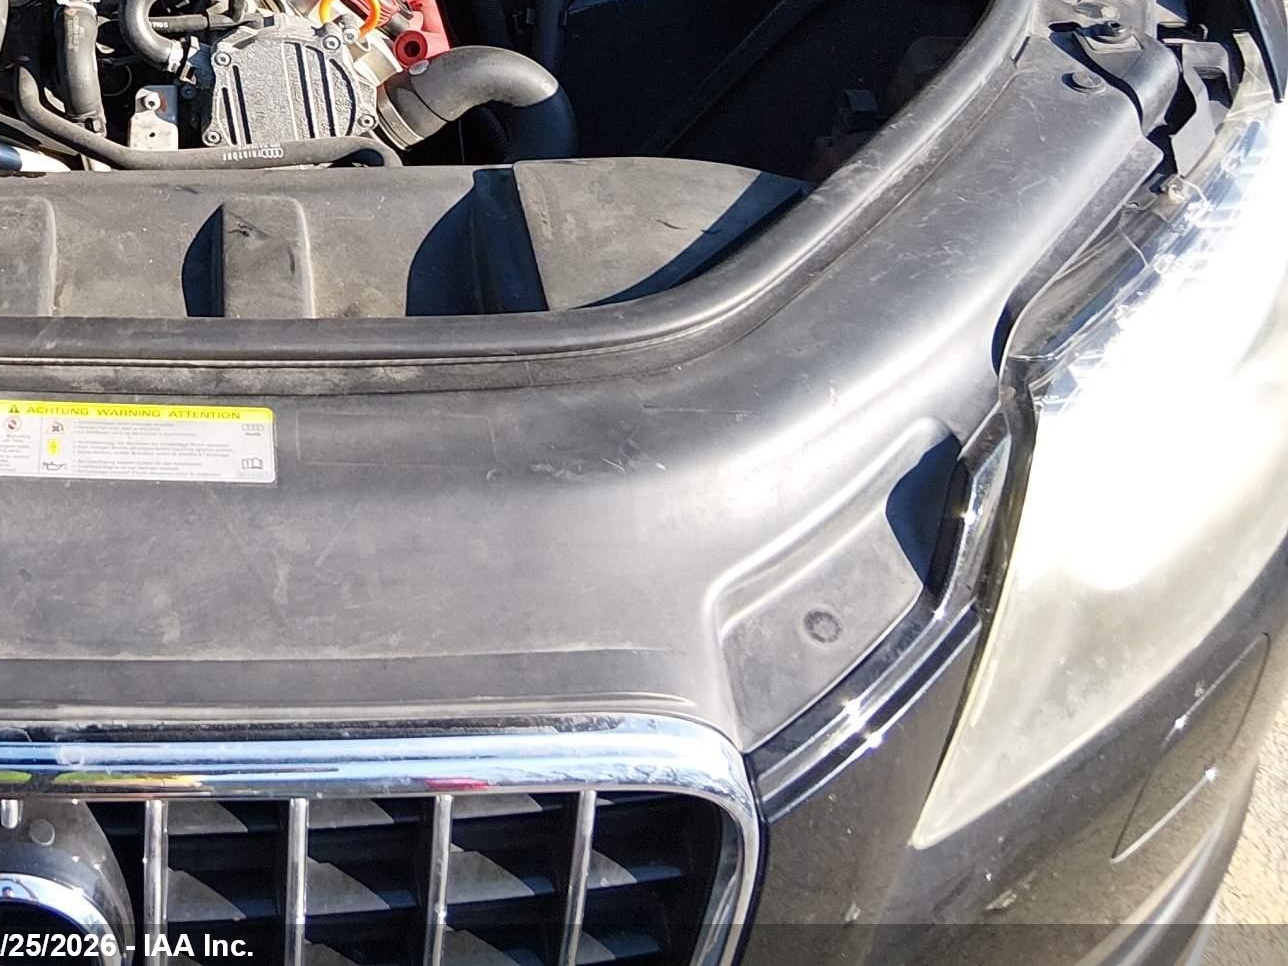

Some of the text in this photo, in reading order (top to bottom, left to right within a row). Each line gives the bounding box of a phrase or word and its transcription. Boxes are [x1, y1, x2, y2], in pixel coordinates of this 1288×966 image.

[25, 405, 241, 419] ACHTUNG WARNING ATTENTION
